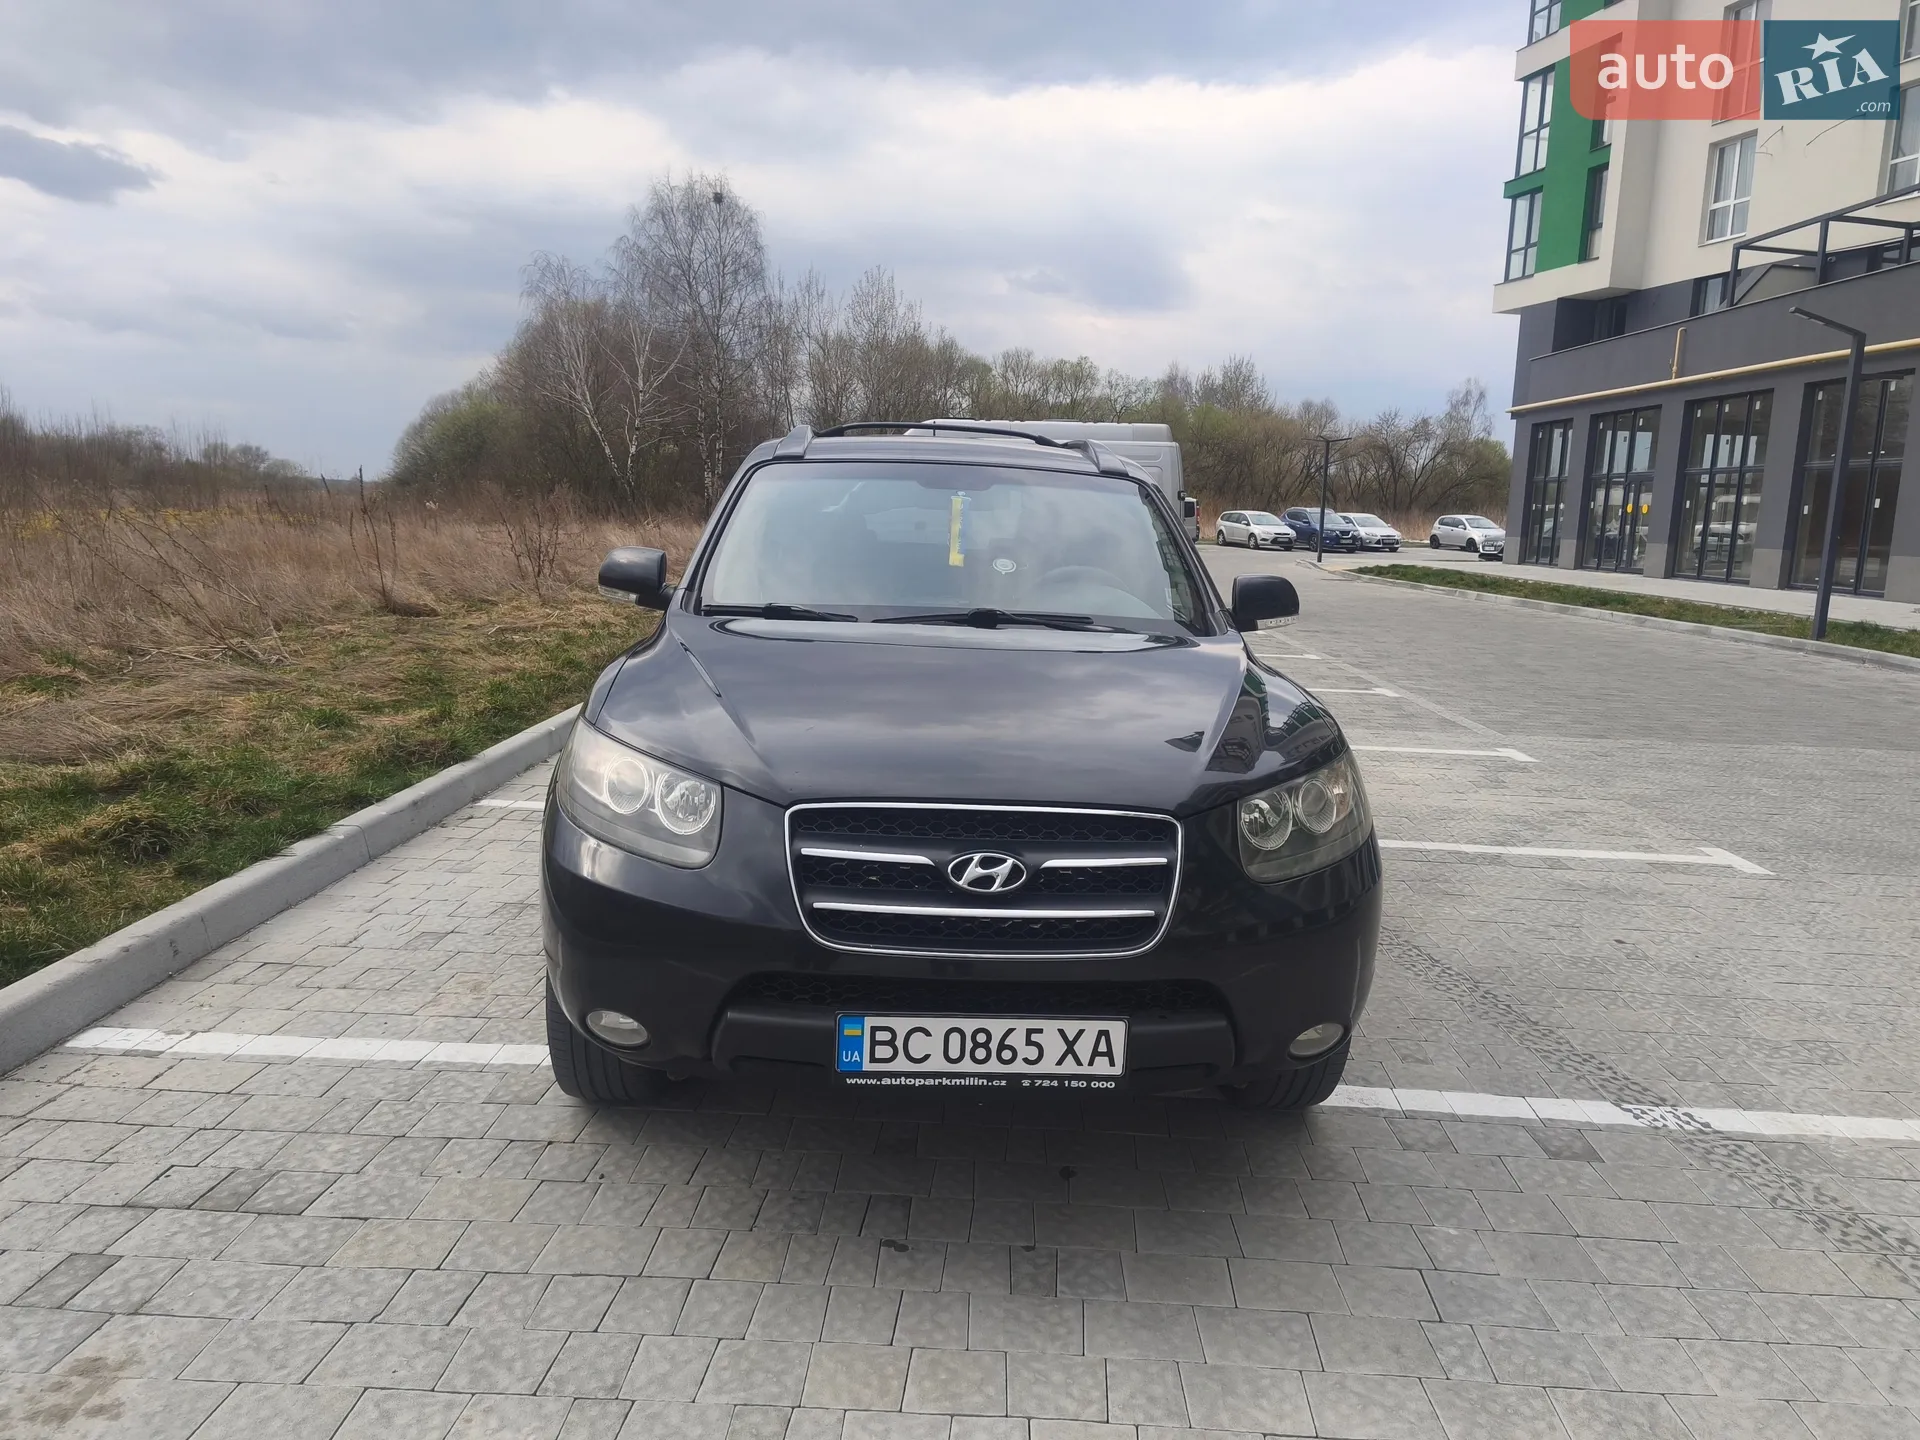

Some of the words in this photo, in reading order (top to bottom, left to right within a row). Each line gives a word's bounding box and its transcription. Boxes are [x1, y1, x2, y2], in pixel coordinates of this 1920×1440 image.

[868, 1025, 932, 1065] BC
[942, 1026, 1044, 1066] 0865
[1055, 1028, 1116, 1068] XA
[842, 1050, 861, 1063] UA
[846, 1075, 1007, 1087] www.autoparkmilin.cz
[1034, 1079, 1059, 1087] 724
[1064, 1080, 1087, 1088] 150
[1090, 1080, 1116, 1089] 000
